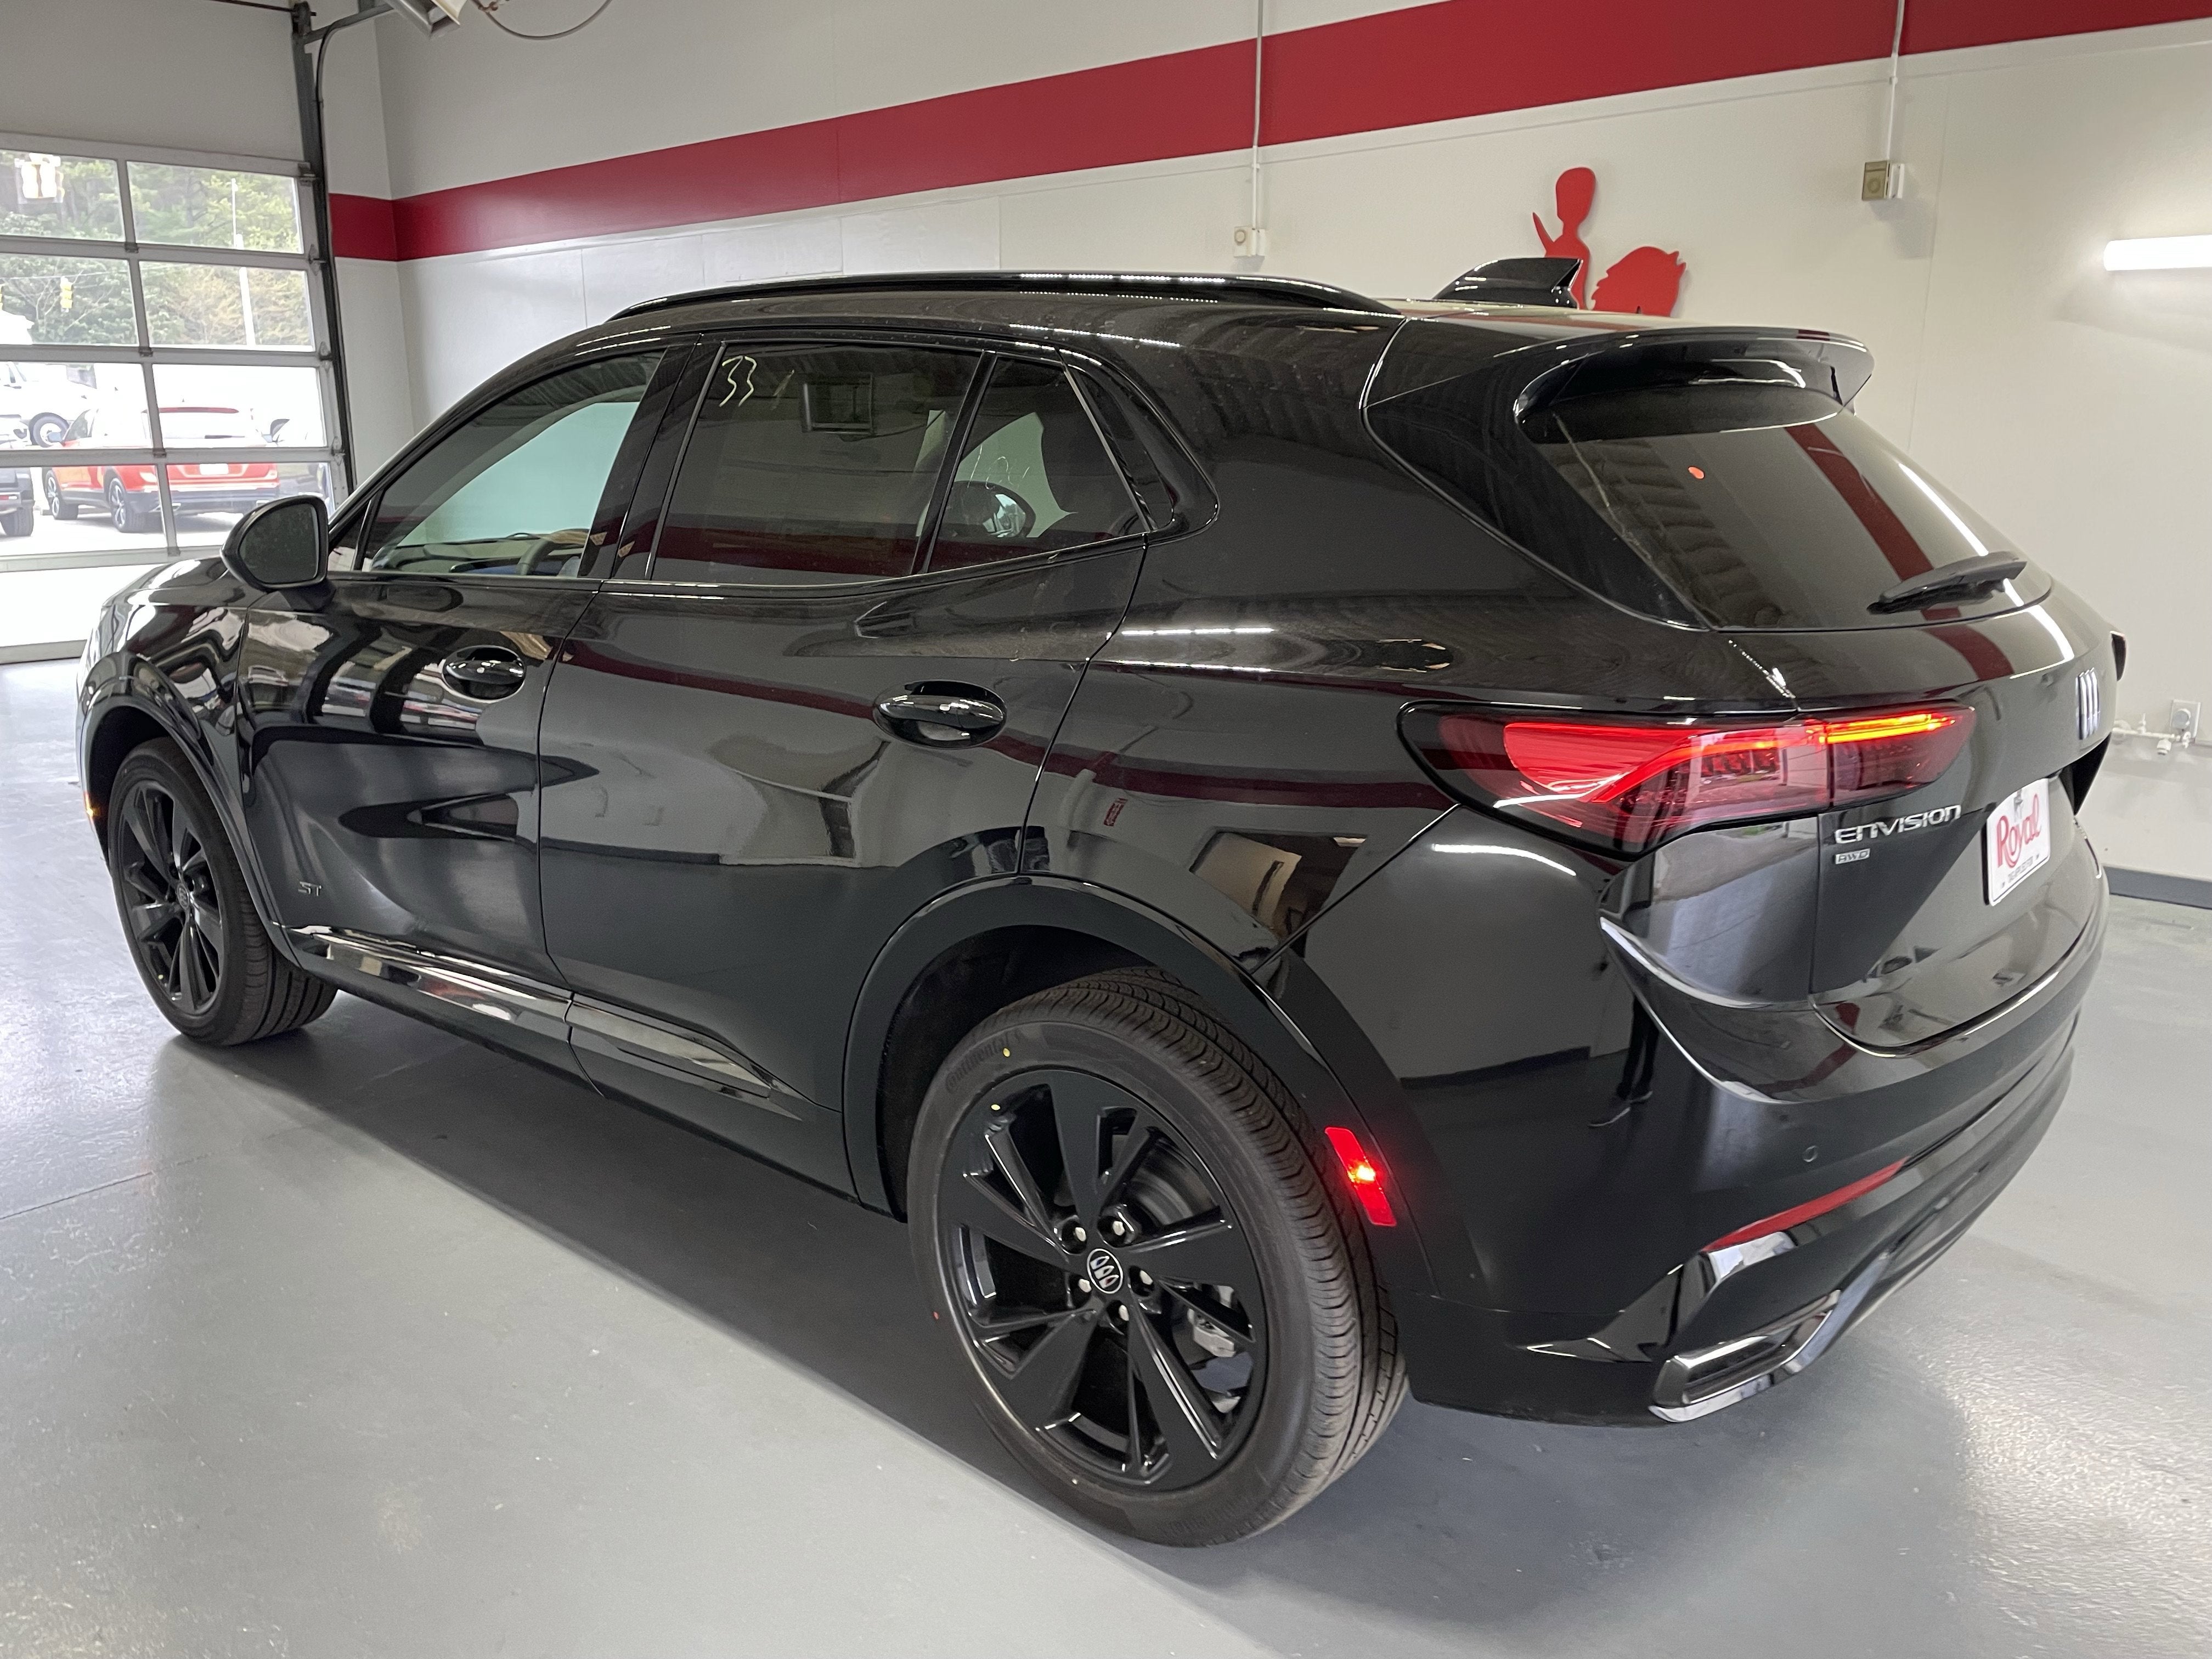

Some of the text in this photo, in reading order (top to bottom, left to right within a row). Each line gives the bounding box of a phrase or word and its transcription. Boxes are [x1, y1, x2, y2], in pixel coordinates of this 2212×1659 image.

[1835, 805, 1961, 844] ENVISION
[1996, 793, 2041, 868] Royal
[1837, 850, 1869, 864] AWD
[298, 881, 322, 896] ST
